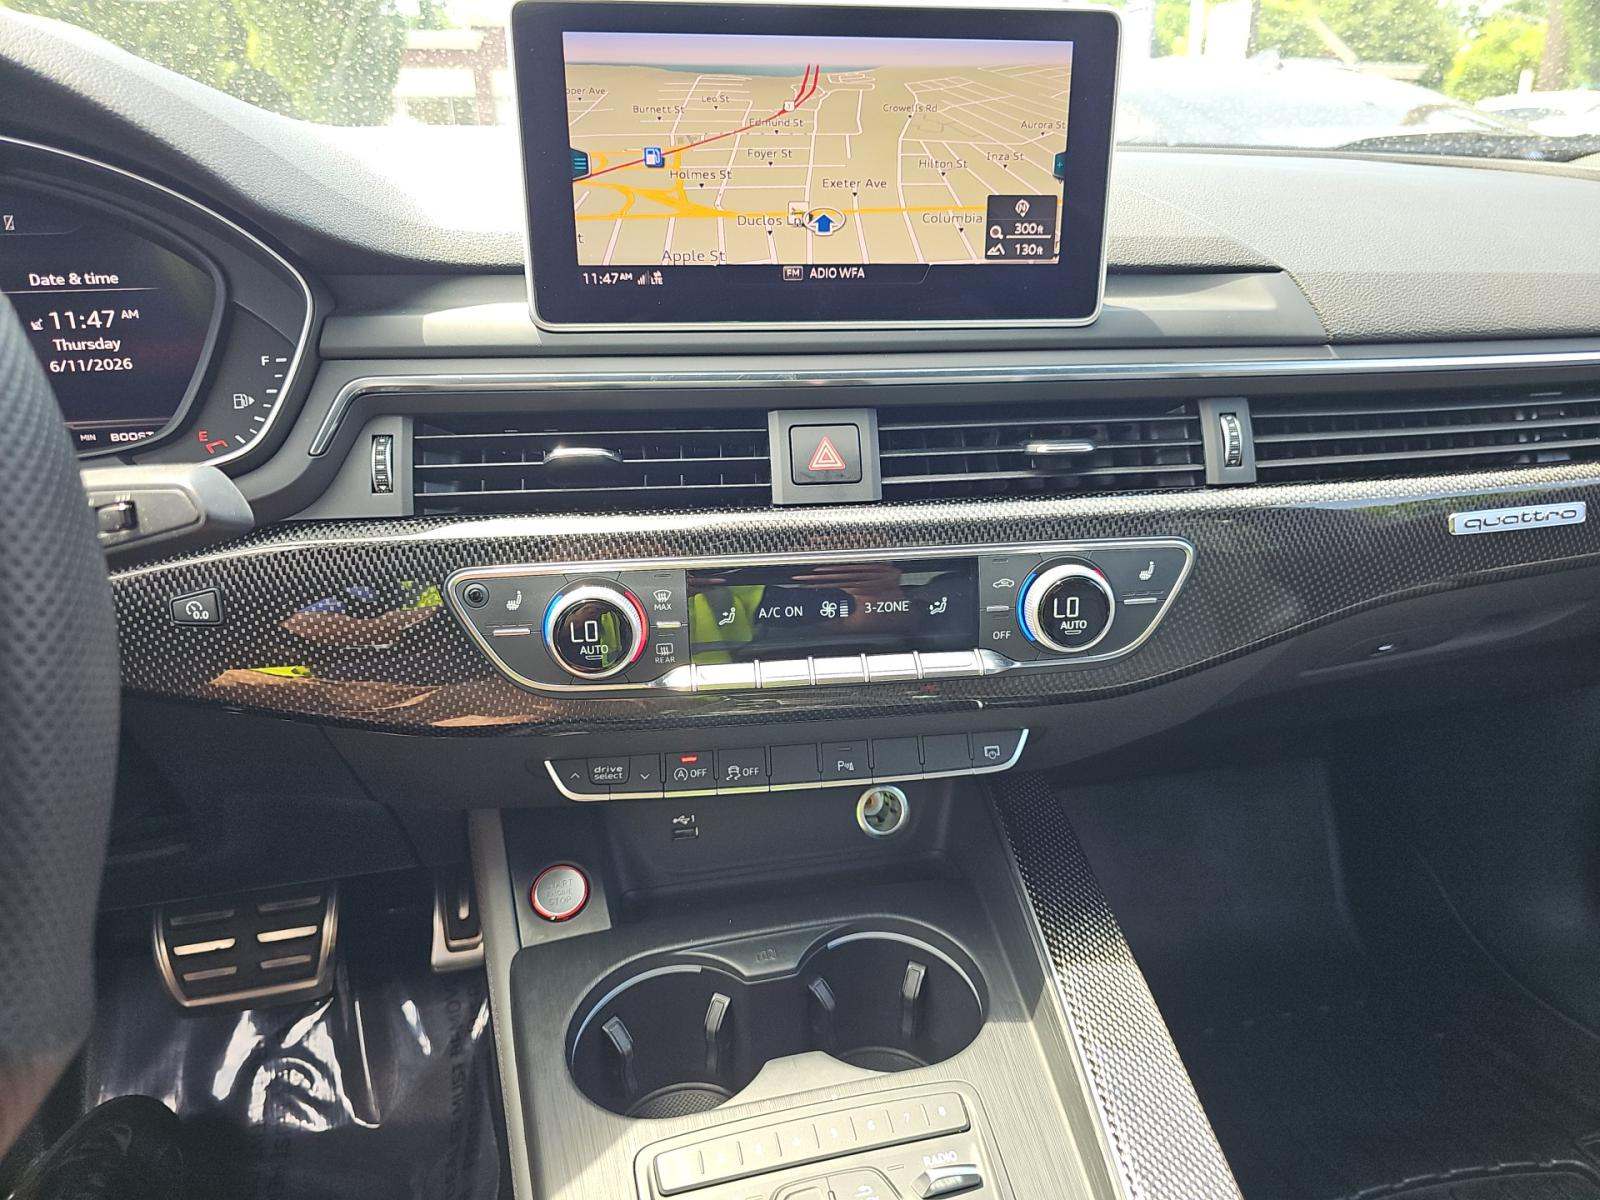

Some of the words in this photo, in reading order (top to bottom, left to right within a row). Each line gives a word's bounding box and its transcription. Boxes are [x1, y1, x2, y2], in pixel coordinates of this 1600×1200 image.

[589, 87, 607, 95] Ave
[716, 95, 730, 103] St
[632, 105, 671, 114] Burnett
[675, 105, 685, 114] St
[882, 103, 923, 113] Crowells
[925, 103, 938, 113] Rd
[749, 118, 791, 127] Edmund
[793, 118, 804, 127] St
[1020, 120, 1054, 129] Aurora
[1056, 121, 1066, 129] St
[747, 149, 776, 160] Foyer
[781, 149, 793, 158] St
[986, 152, 1011, 161] Inza
[1012, 152, 1024, 161] St
[918, 159, 953, 169] Hilton
[956, 160, 969, 169] St
[669, 169, 716, 180] Holmes
[719, 169, 732, 180] St
[822, 178, 861, 188] Exeter
[865, 178, 887, 188] Ave
[737, 214, 782, 226] Duclos
[922, 213, 983, 224] Columbia
[661, 250, 706, 265] Apple
[710, 250, 726, 262] St
[785, 269, 800, 278] FM
[809, 267, 838, 280] ADIO
[839, 267, 866, 279] WFA
[29, 273, 66, 287] Date
[68, 273, 82, 285] &
[84, 272, 119, 285] time
[48, 309, 115, 330] 11:47
[121, 309, 140, 320] AM
[53, 338, 121, 353] Thursday
[50, 358, 133, 373] 6/11/2026
[261, 356, 270, 366] F
[80, 434, 97, 442] MIN
[1464, 509, 1577, 531] quattro
[654, 602, 673, 611] MAX
[864, 600, 910, 614] 3-ZONE
[1053, 596, 1080, 619] LO
[758, 606, 781, 619] A/C
[785, 605, 804, 618] ON
[1060, 620, 1088, 630] AUTO
[570, 620, 599, 643] LO
[992, 630, 1012, 640] OFF
[580, 644, 609, 655] AUTO
[654, 655, 676, 664] REAR
[593, 765, 624, 775] drive
[690, 768, 707, 778] OFF
[743, 767, 760, 777] OFF
[593, 772, 624, 781] select
[923, 1150, 958, 1168] RADIO
